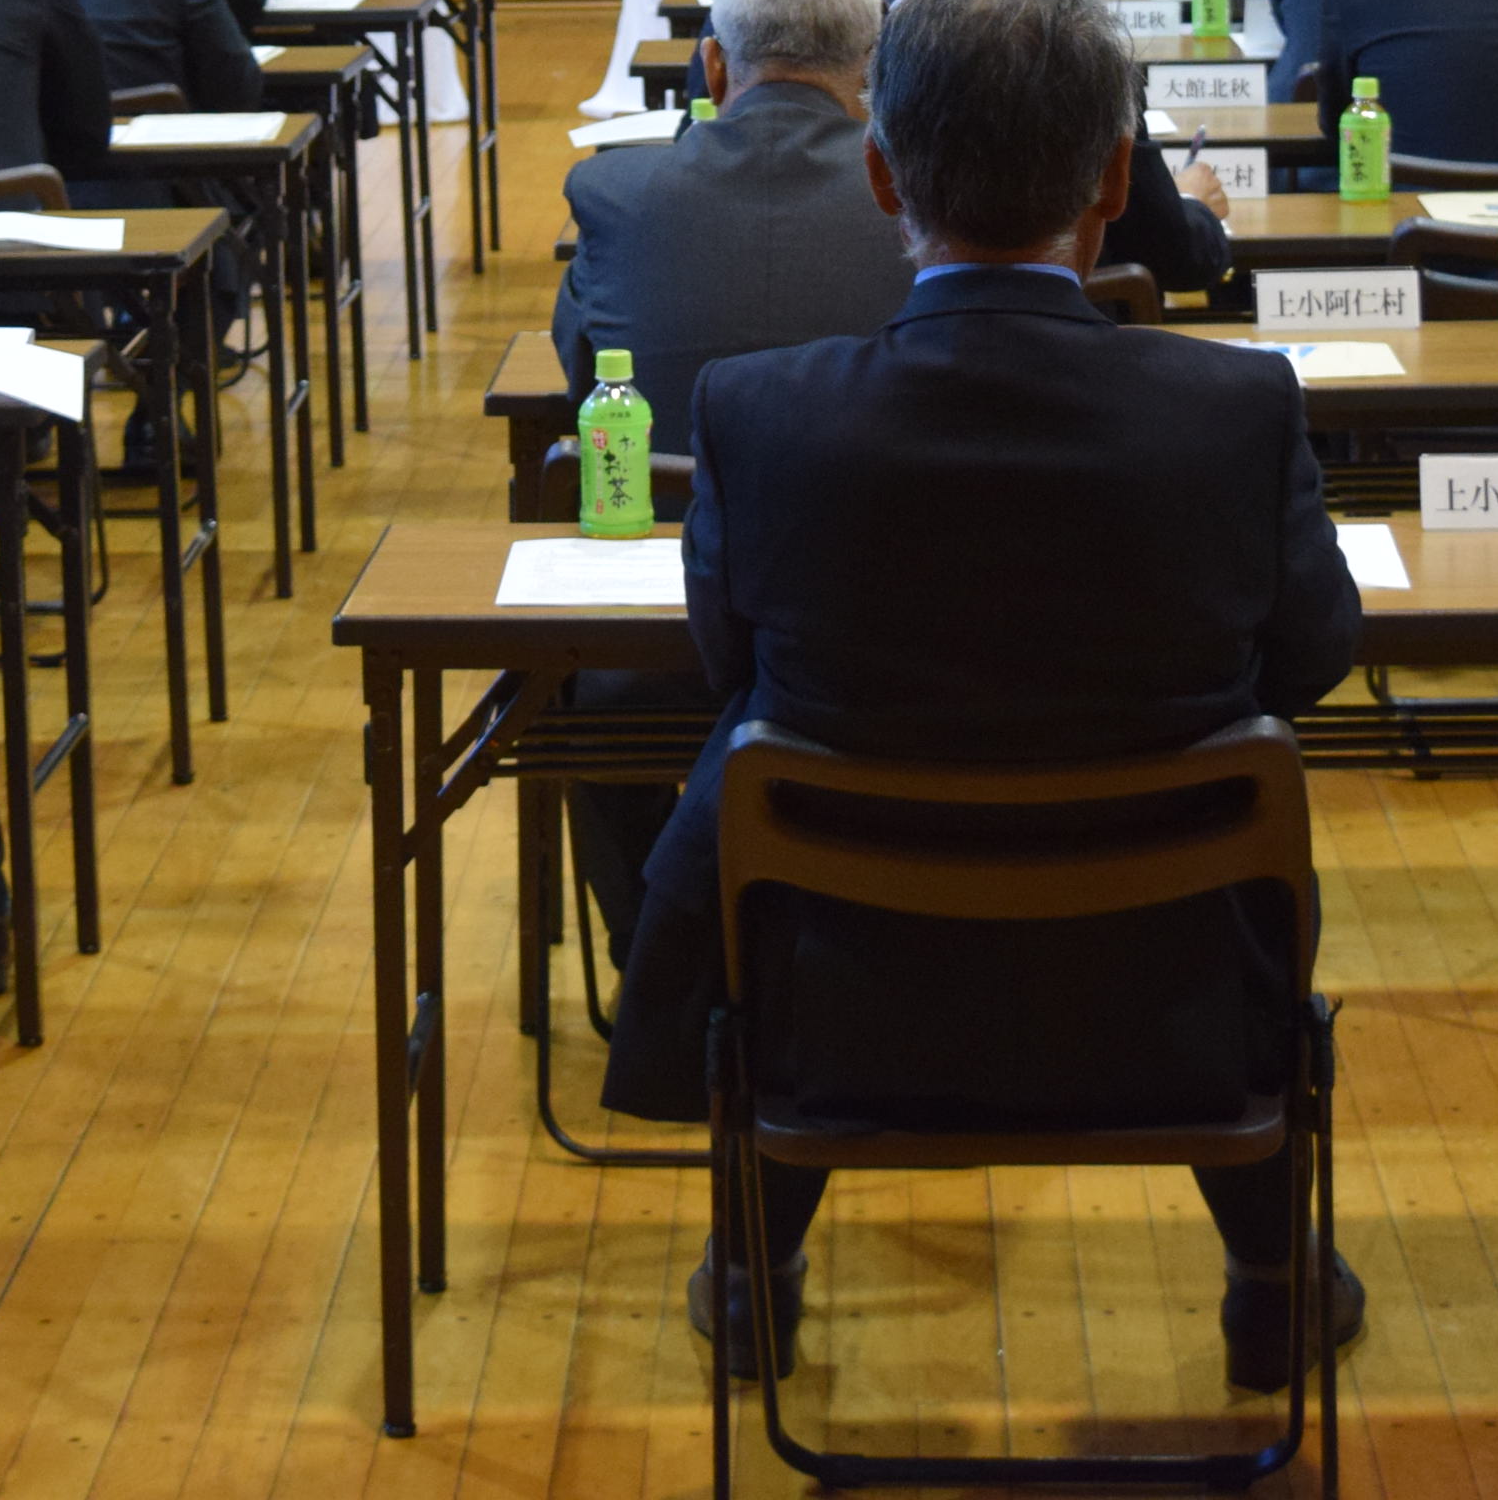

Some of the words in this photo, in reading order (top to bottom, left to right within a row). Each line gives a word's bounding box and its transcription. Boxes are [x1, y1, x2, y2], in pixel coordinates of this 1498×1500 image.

[1165, 77, 1251, 99] 大館北秋
[1269, 287, 1405, 319] 上小阿仁村
